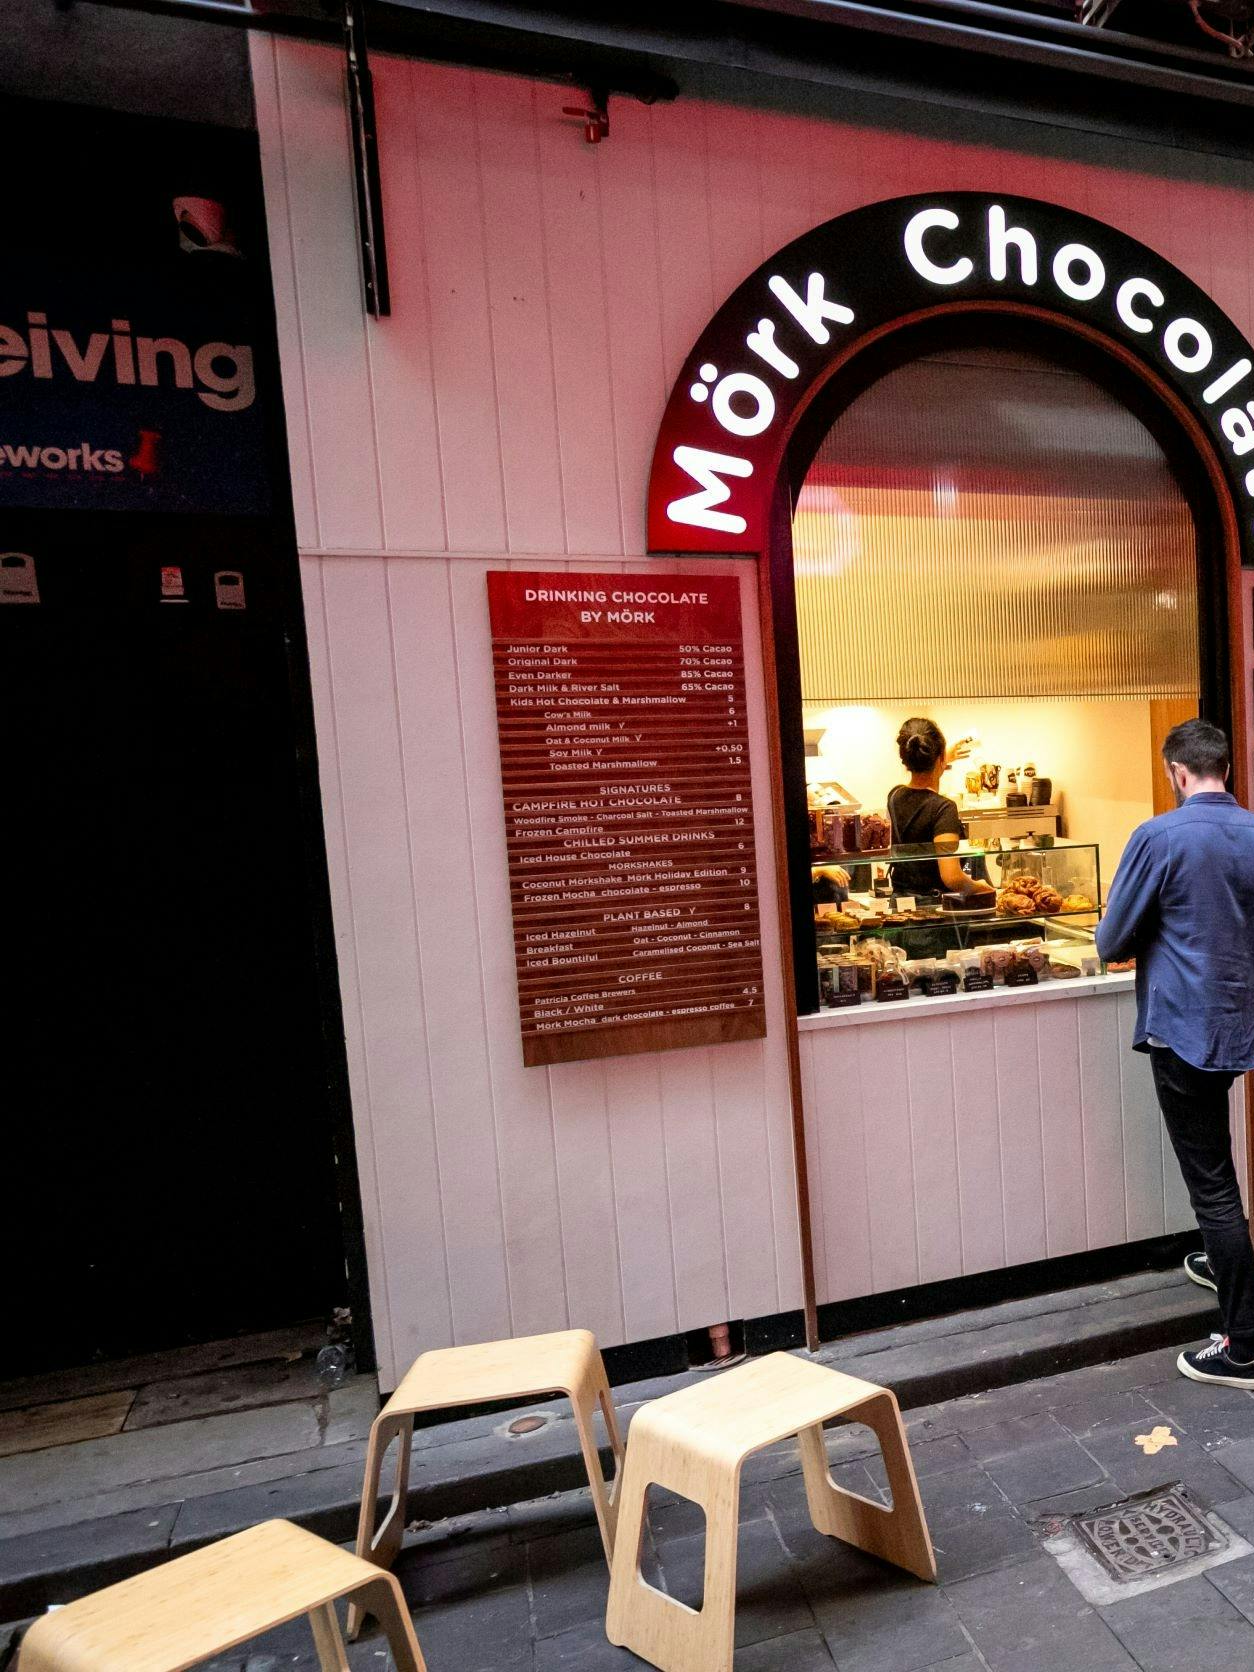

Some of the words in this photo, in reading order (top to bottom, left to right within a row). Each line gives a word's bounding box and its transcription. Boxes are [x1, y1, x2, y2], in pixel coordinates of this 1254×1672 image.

[666, 271, 855, 535] Mörk
[0, 442, 126, 473] works
[525, 589, 607, 602] DRINKING
[612, 591, 708, 604] CHOCOLATE
[581, 611, 601, 622] BY
[606, 608, 655, 623] MÖRK
[507, 645, 540, 653] Junior
[543, 645, 568, 653] Dark
[679, 645, 700, 653] 50%
[702, 645, 732, 653] Cacao
[508, 658, 550, 666] Original
[508, 672, 534, 680] Even
[509, 685, 534, 693] Dark
[571, 684, 598, 692] River
[510, 698, 533, 706] Kids
[536, 698, 555, 706] Hot
[558, 697, 609, 705] Chocolate
[622, 696, 686, 704] Marshmallow
[546, 723, 586, 731] Almond
[573, 736, 610, 744] Coconut
[549, 762, 589, 770] Toasted
[592, 760, 657, 769] Marshmallow
[600, 784, 671, 795] SIGNATURES
[513, 800, 577, 811] CAMPFIRE
[580, 799, 604, 808] HOT
[609, 796, 682, 807] CHOCOLATE
[514, 816, 556, 825] Woodfire
[558, 814, 588, 823] Smoke
[597, 812, 634, 820] Charcoal
[661, 809, 694, 817] Toasted
[696, 806, 749, 815] Marshmallow
[515, 829, 553, 837] Frozen
[555, 826, 604, 836] Campfire
[563, 838, 615, 848] CHILLED
[619, 833, 669, 844] SUMMER
[672, 831, 715, 841] DRINKS
[520, 856, 543, 864] Iced
[545, 853, 577, 862] House
[580, 850, 631, 859] Chocolate
[522, 880, 566, 889] Coconut
[694, 868, 728, 877] Edition
[524, 894, 560, 902] Frozen
[562, 891, 596, 900] Mocha
[601, 886, 650, 896] chocolate
[659, 883, 702, 892] espresso
[603, 911, 640, 922] PLANT
[643, 908, 680, 919] BASED
[631, 923, 668, 932] Hazelnut
[676, 919, 709, 928] Almond
[526, 933, 548, 941] Iced
[551, 928, 597, 939] Hazelnut
[657, 934, 692, 942] Coconut
[699, 929, 740, 938] Cinnamon
[526, 943, 573, 954] Breakfast
[632, 946, 684, 957] Caramelised
[686, 942, 721, 952] Coconut
[744, 939, 760, 947] Salt
[527, 959, 549, 967] Iced
[552, 954, 599, 965] Bountiful
[618, 971, 662, 983] COFFEE
[535, 996, 568, 1005] Patricia
[570, 993, 599, 1001] Coffee
[534, 1009, 562, 1018] Black
[574, 1004, 604, 1013] White
[564, 1018, 596, 1027] Mocha
[601, 1015, 621, 1023] dark
[622, 1009, 664, 1020] chocolate
[671, 1006, 708, 1015] espresso
[709, 1003, 735, 1011] coffee
